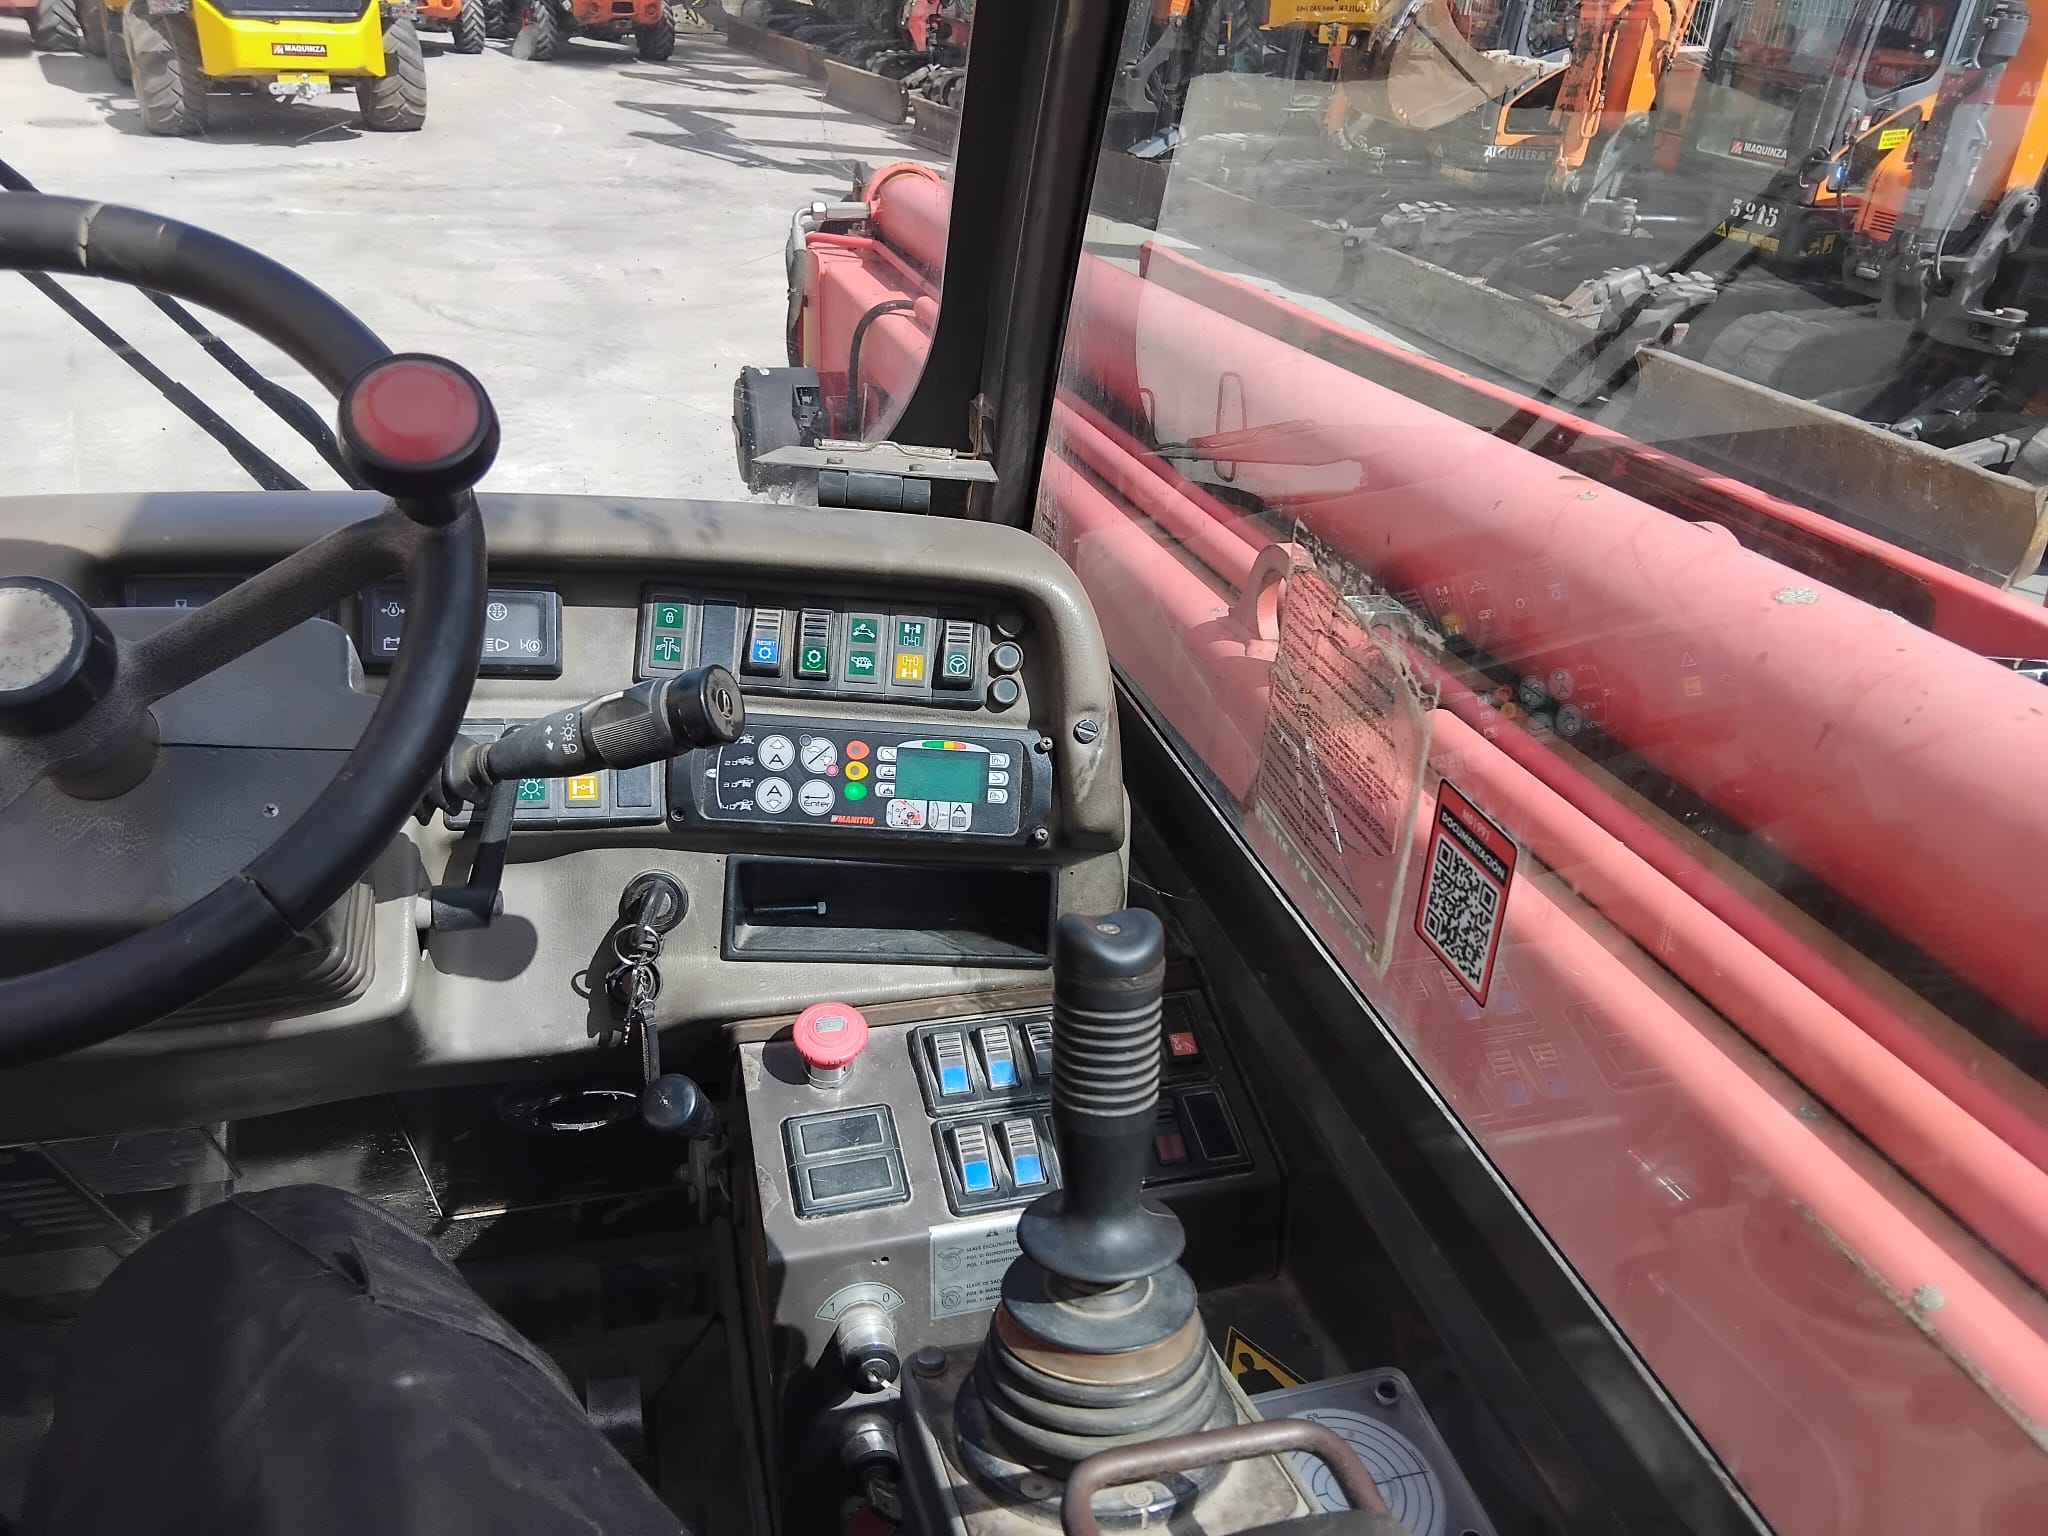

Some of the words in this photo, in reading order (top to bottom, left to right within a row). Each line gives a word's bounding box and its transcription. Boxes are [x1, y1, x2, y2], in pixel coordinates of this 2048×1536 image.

[284, 44, 326, 53] MAQUINZA
[1743, 142, 1788, 159] MAQUINZA
[1729, 198, 1779, 228] 3215
[803, 799, 831, 808] Enter
[837, 815, 875, 825] MANITOU
[1441, 811, 1506, 880] DOCUMENTACIÓN
[985, 1255, 1018, 1265] DISPOSITIVO
[882, 1292, 890, 1303] 0
